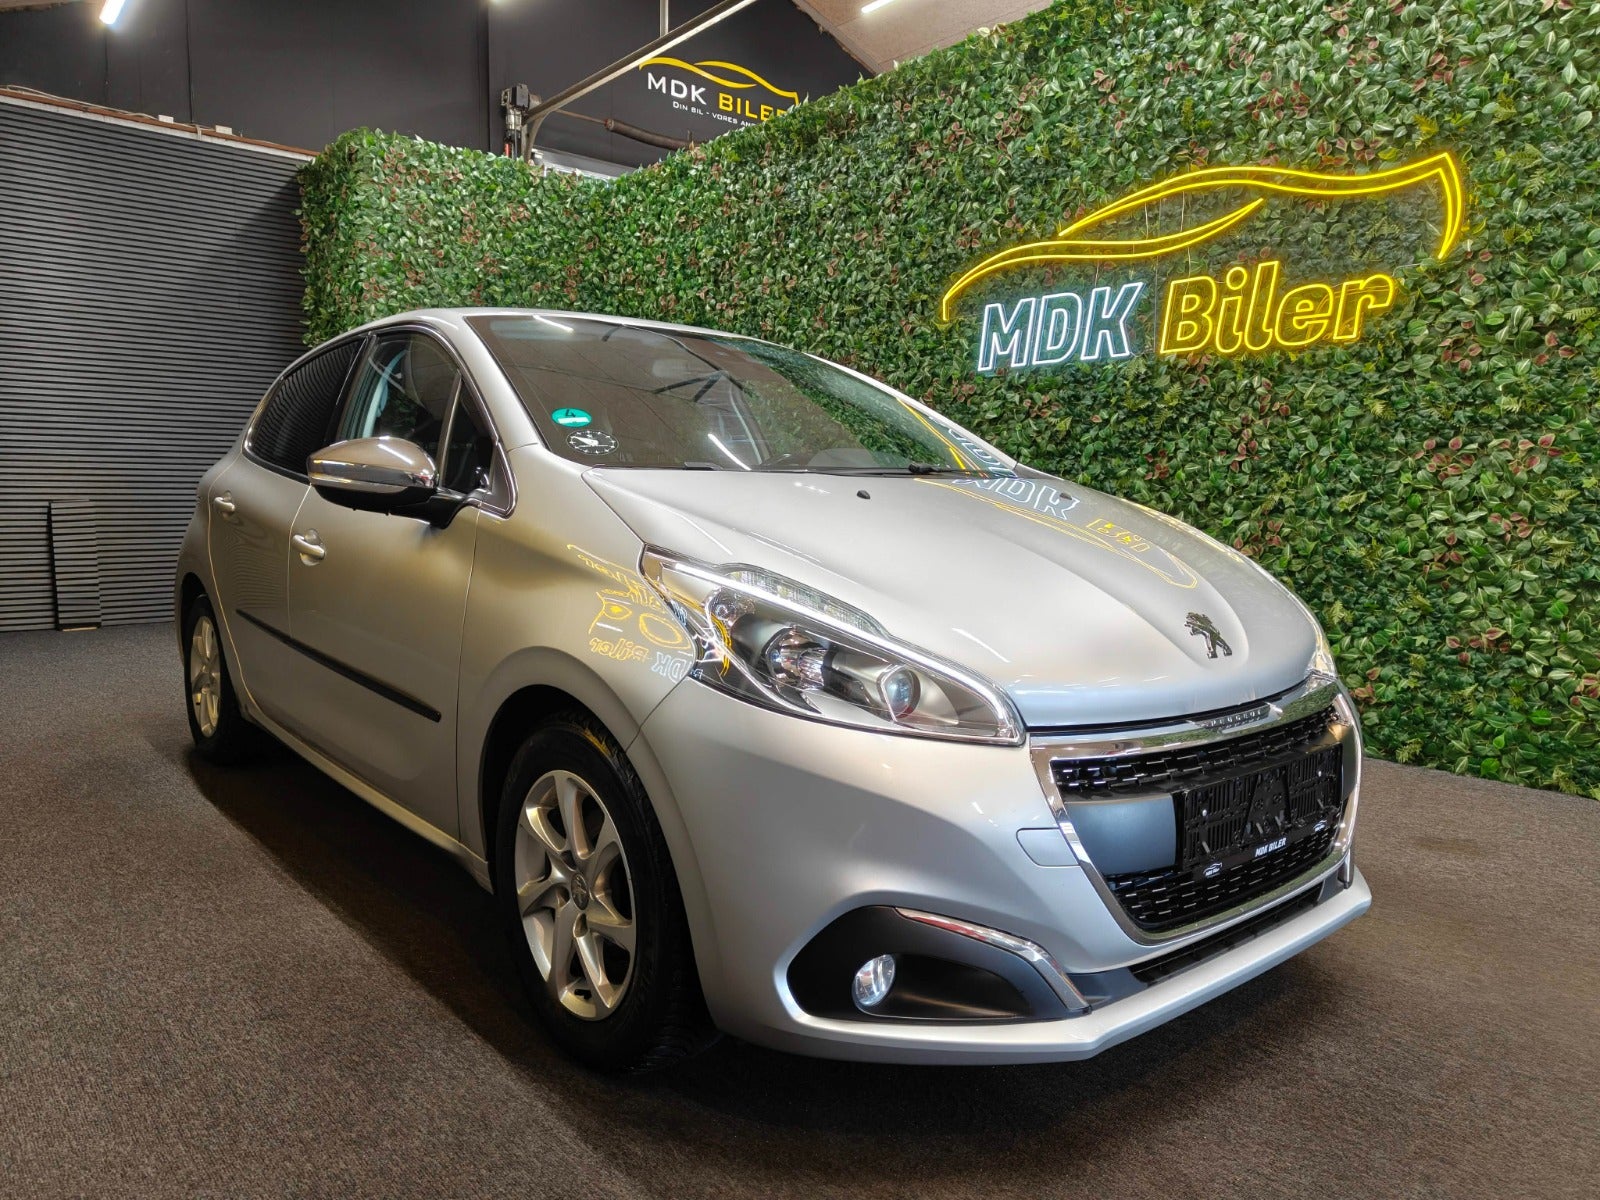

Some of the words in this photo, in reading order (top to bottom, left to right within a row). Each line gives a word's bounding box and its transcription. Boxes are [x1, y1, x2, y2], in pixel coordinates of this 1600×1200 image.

[647, 72, 707, 106] MDK
[672, 101, 689, 111] DIN
[690, 106, 704, 116] BIL
[711, 112, 738, 125] VORES
[977, 280, 1145, 373] MDK
[1160, 260, 1395, 354] Biler
[1268, 837, 1287, 852] BILER
